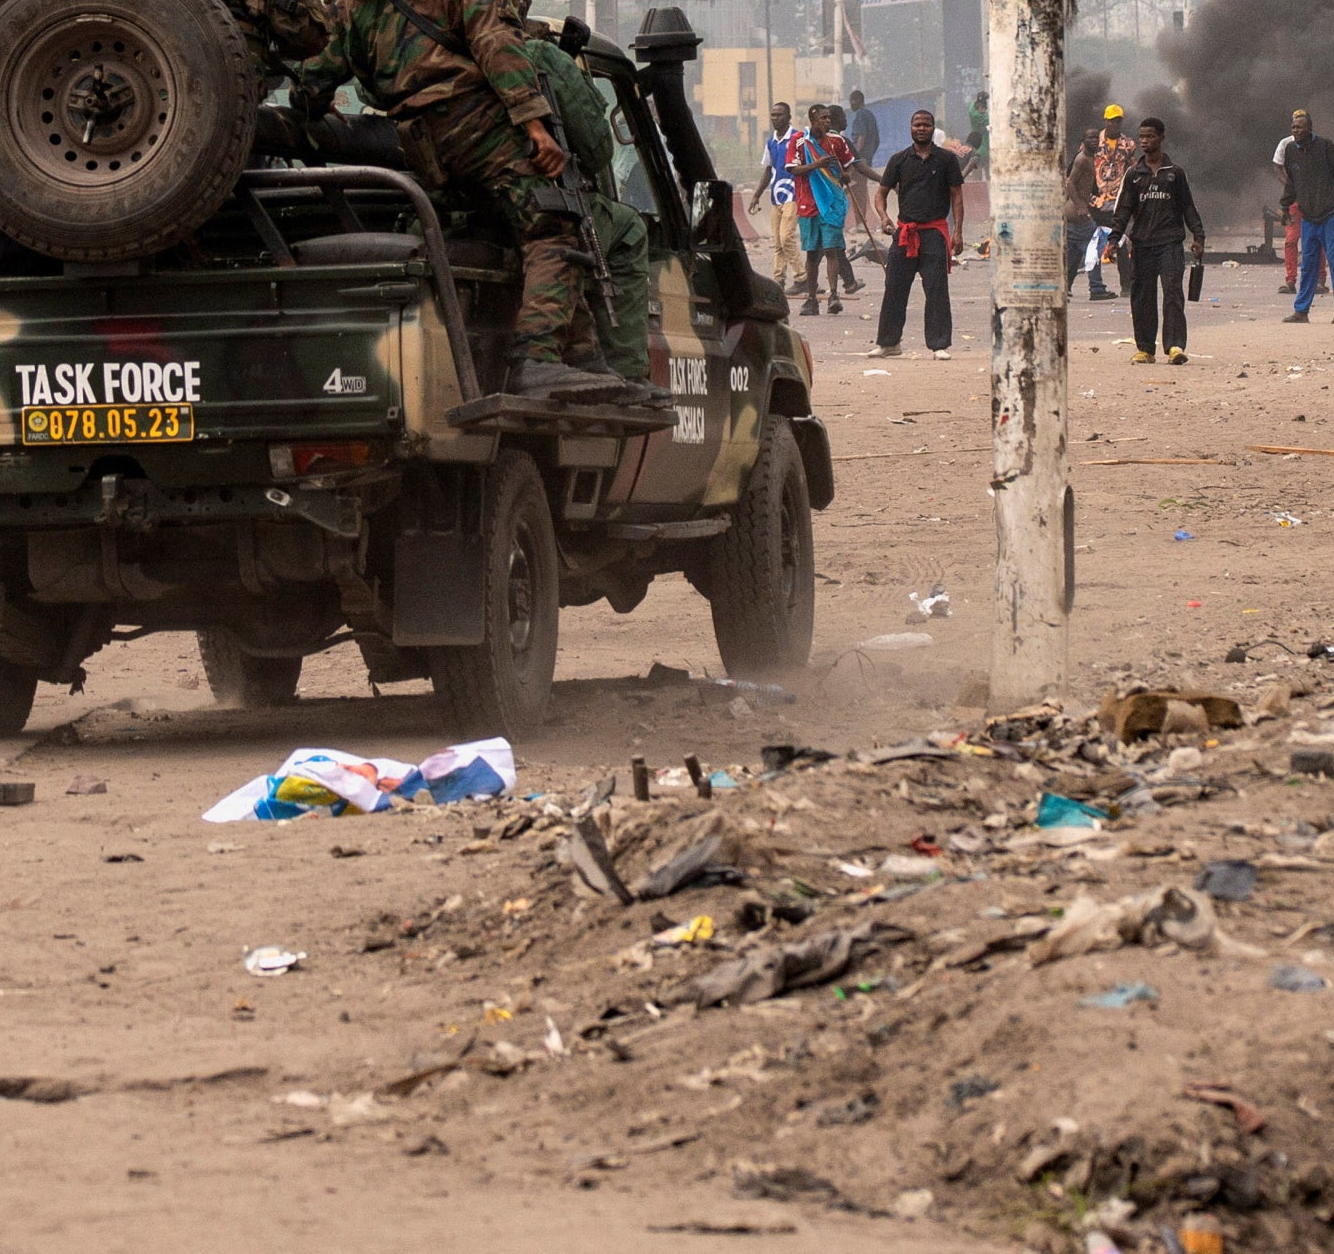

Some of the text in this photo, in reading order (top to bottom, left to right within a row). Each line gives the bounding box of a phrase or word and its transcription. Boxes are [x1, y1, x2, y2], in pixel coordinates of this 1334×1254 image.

[15, 360, 201, 405] TASK FORCE
[322, 367, 367, 394] 4WD
[668, 357, 708, 395] TASK FORCE
[730, 366, 749, 392] 002
[49, 407, 180, 440] 078.05.23
